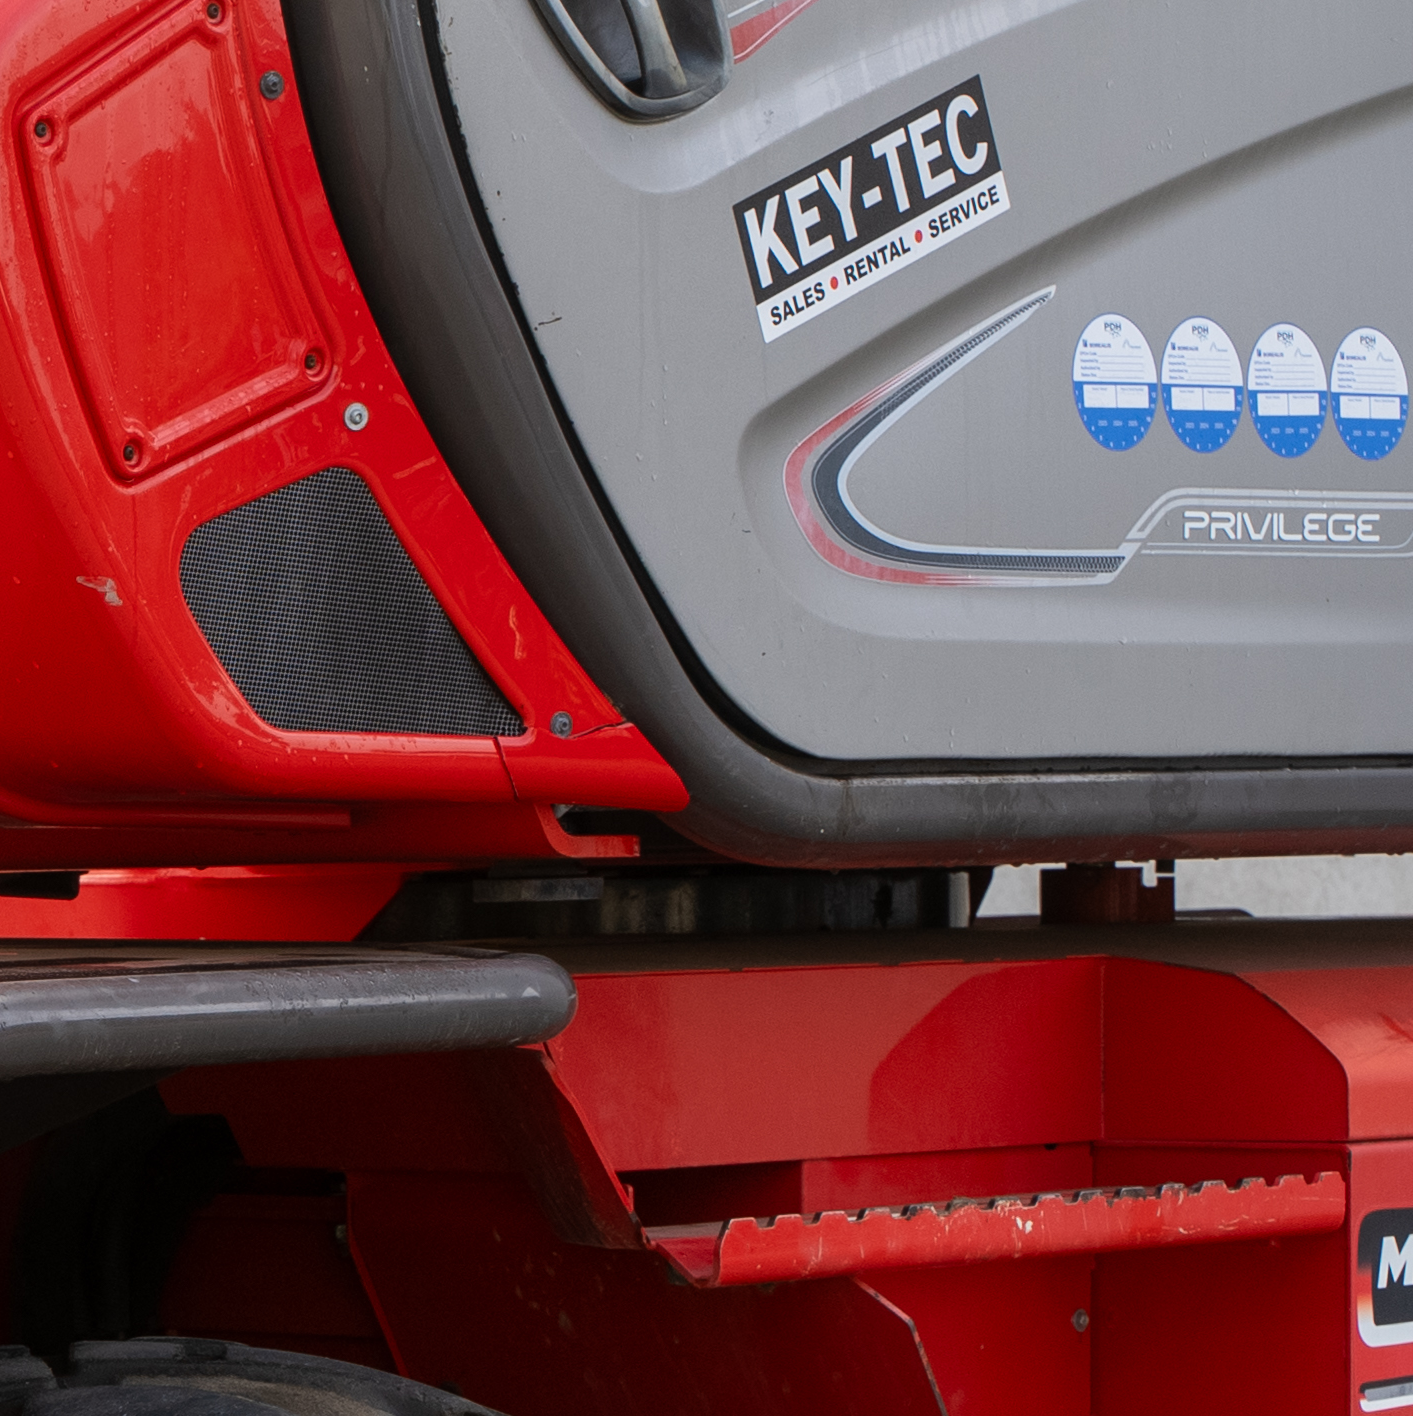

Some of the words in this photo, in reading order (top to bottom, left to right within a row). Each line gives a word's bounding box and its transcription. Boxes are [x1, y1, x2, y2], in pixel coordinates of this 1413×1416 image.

[743, 94, 988, 289] KEY-TEC
[770, 282, 825, 326] SALES
[844, 236, 911, 285] RENTAL
[928, 185, 1000, 238] SERVICE
[1104, 322, 1122, 331] PDH
[1192, 325, 1209, 334] PDH
[1277, 332, 1294, 341] PDH
[1359, 336, 1376, 345] PDH
[1183, 511, 1381, 542] PRIVILEGE
